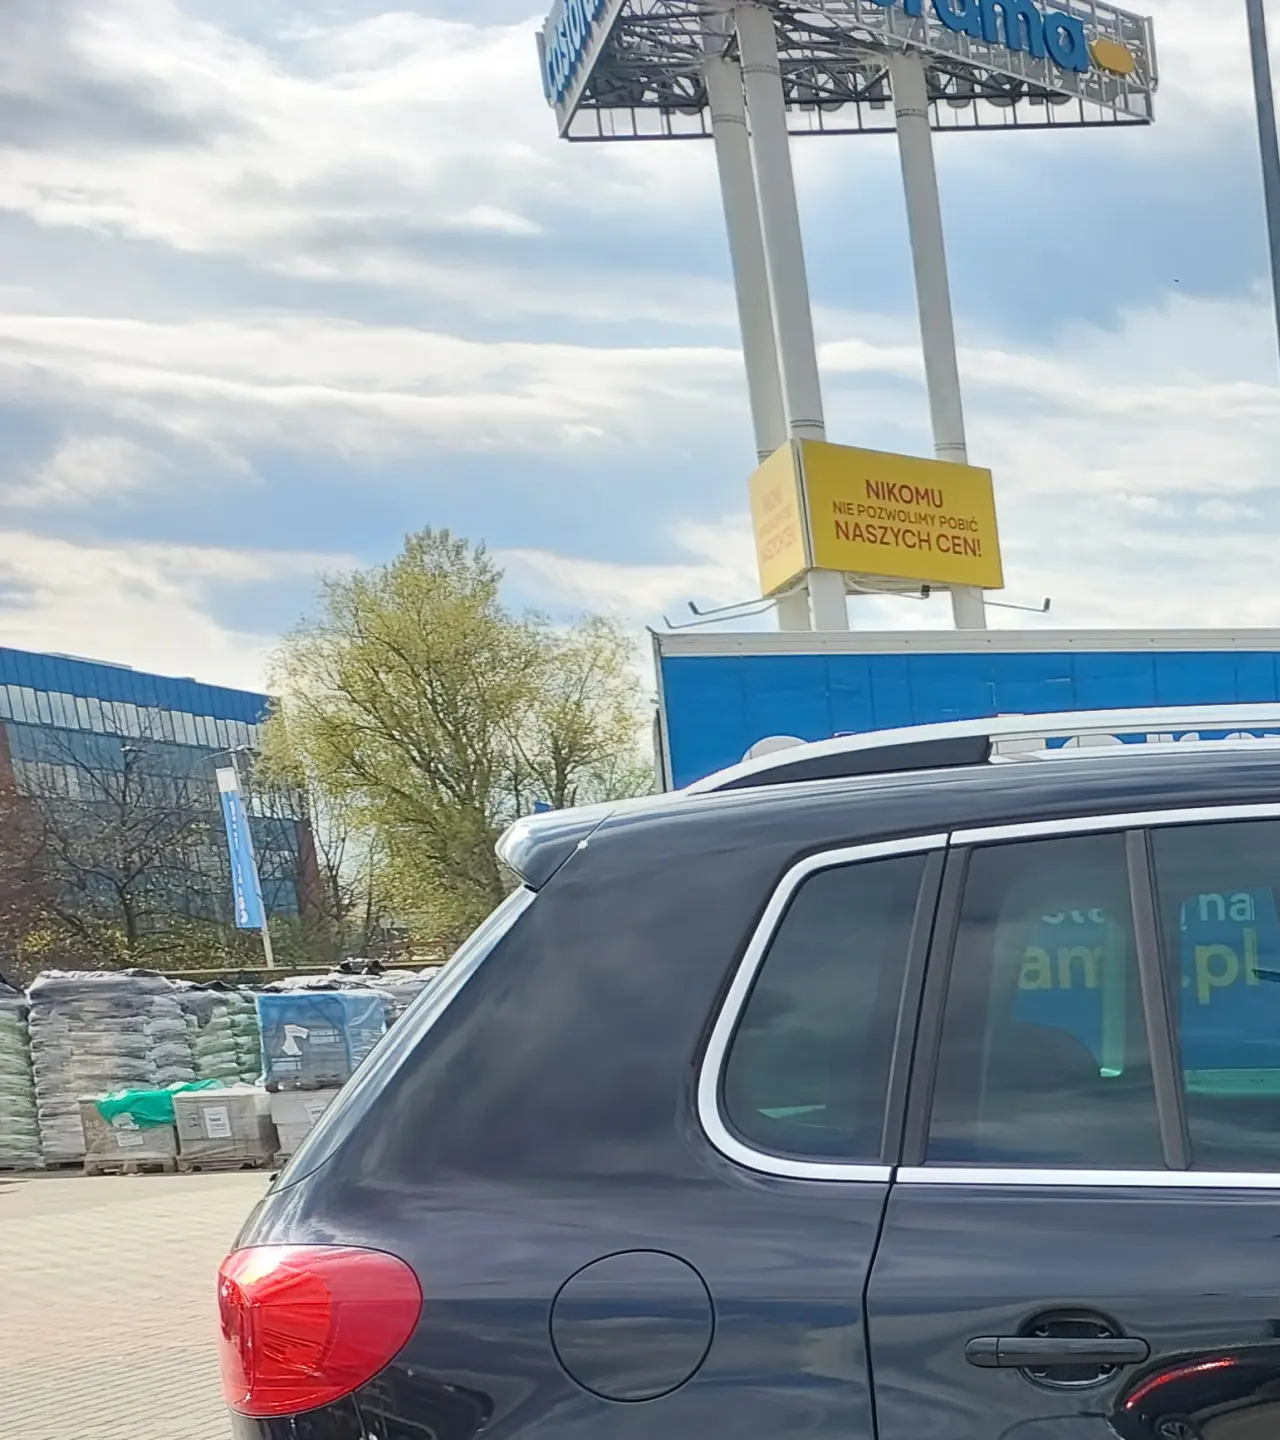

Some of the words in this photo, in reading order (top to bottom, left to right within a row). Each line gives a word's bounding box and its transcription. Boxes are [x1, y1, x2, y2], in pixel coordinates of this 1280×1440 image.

[865, 479, 944, 508] NIKOMU
[833, 501, 854, 516] NIE
[857, 505, 936, 526] POZWOLIMY
[939, 515, 979, 533] POBIĆ
[834, 520, 932, 551] NASZYCH
[936, 533, 982, 558] CEN!
